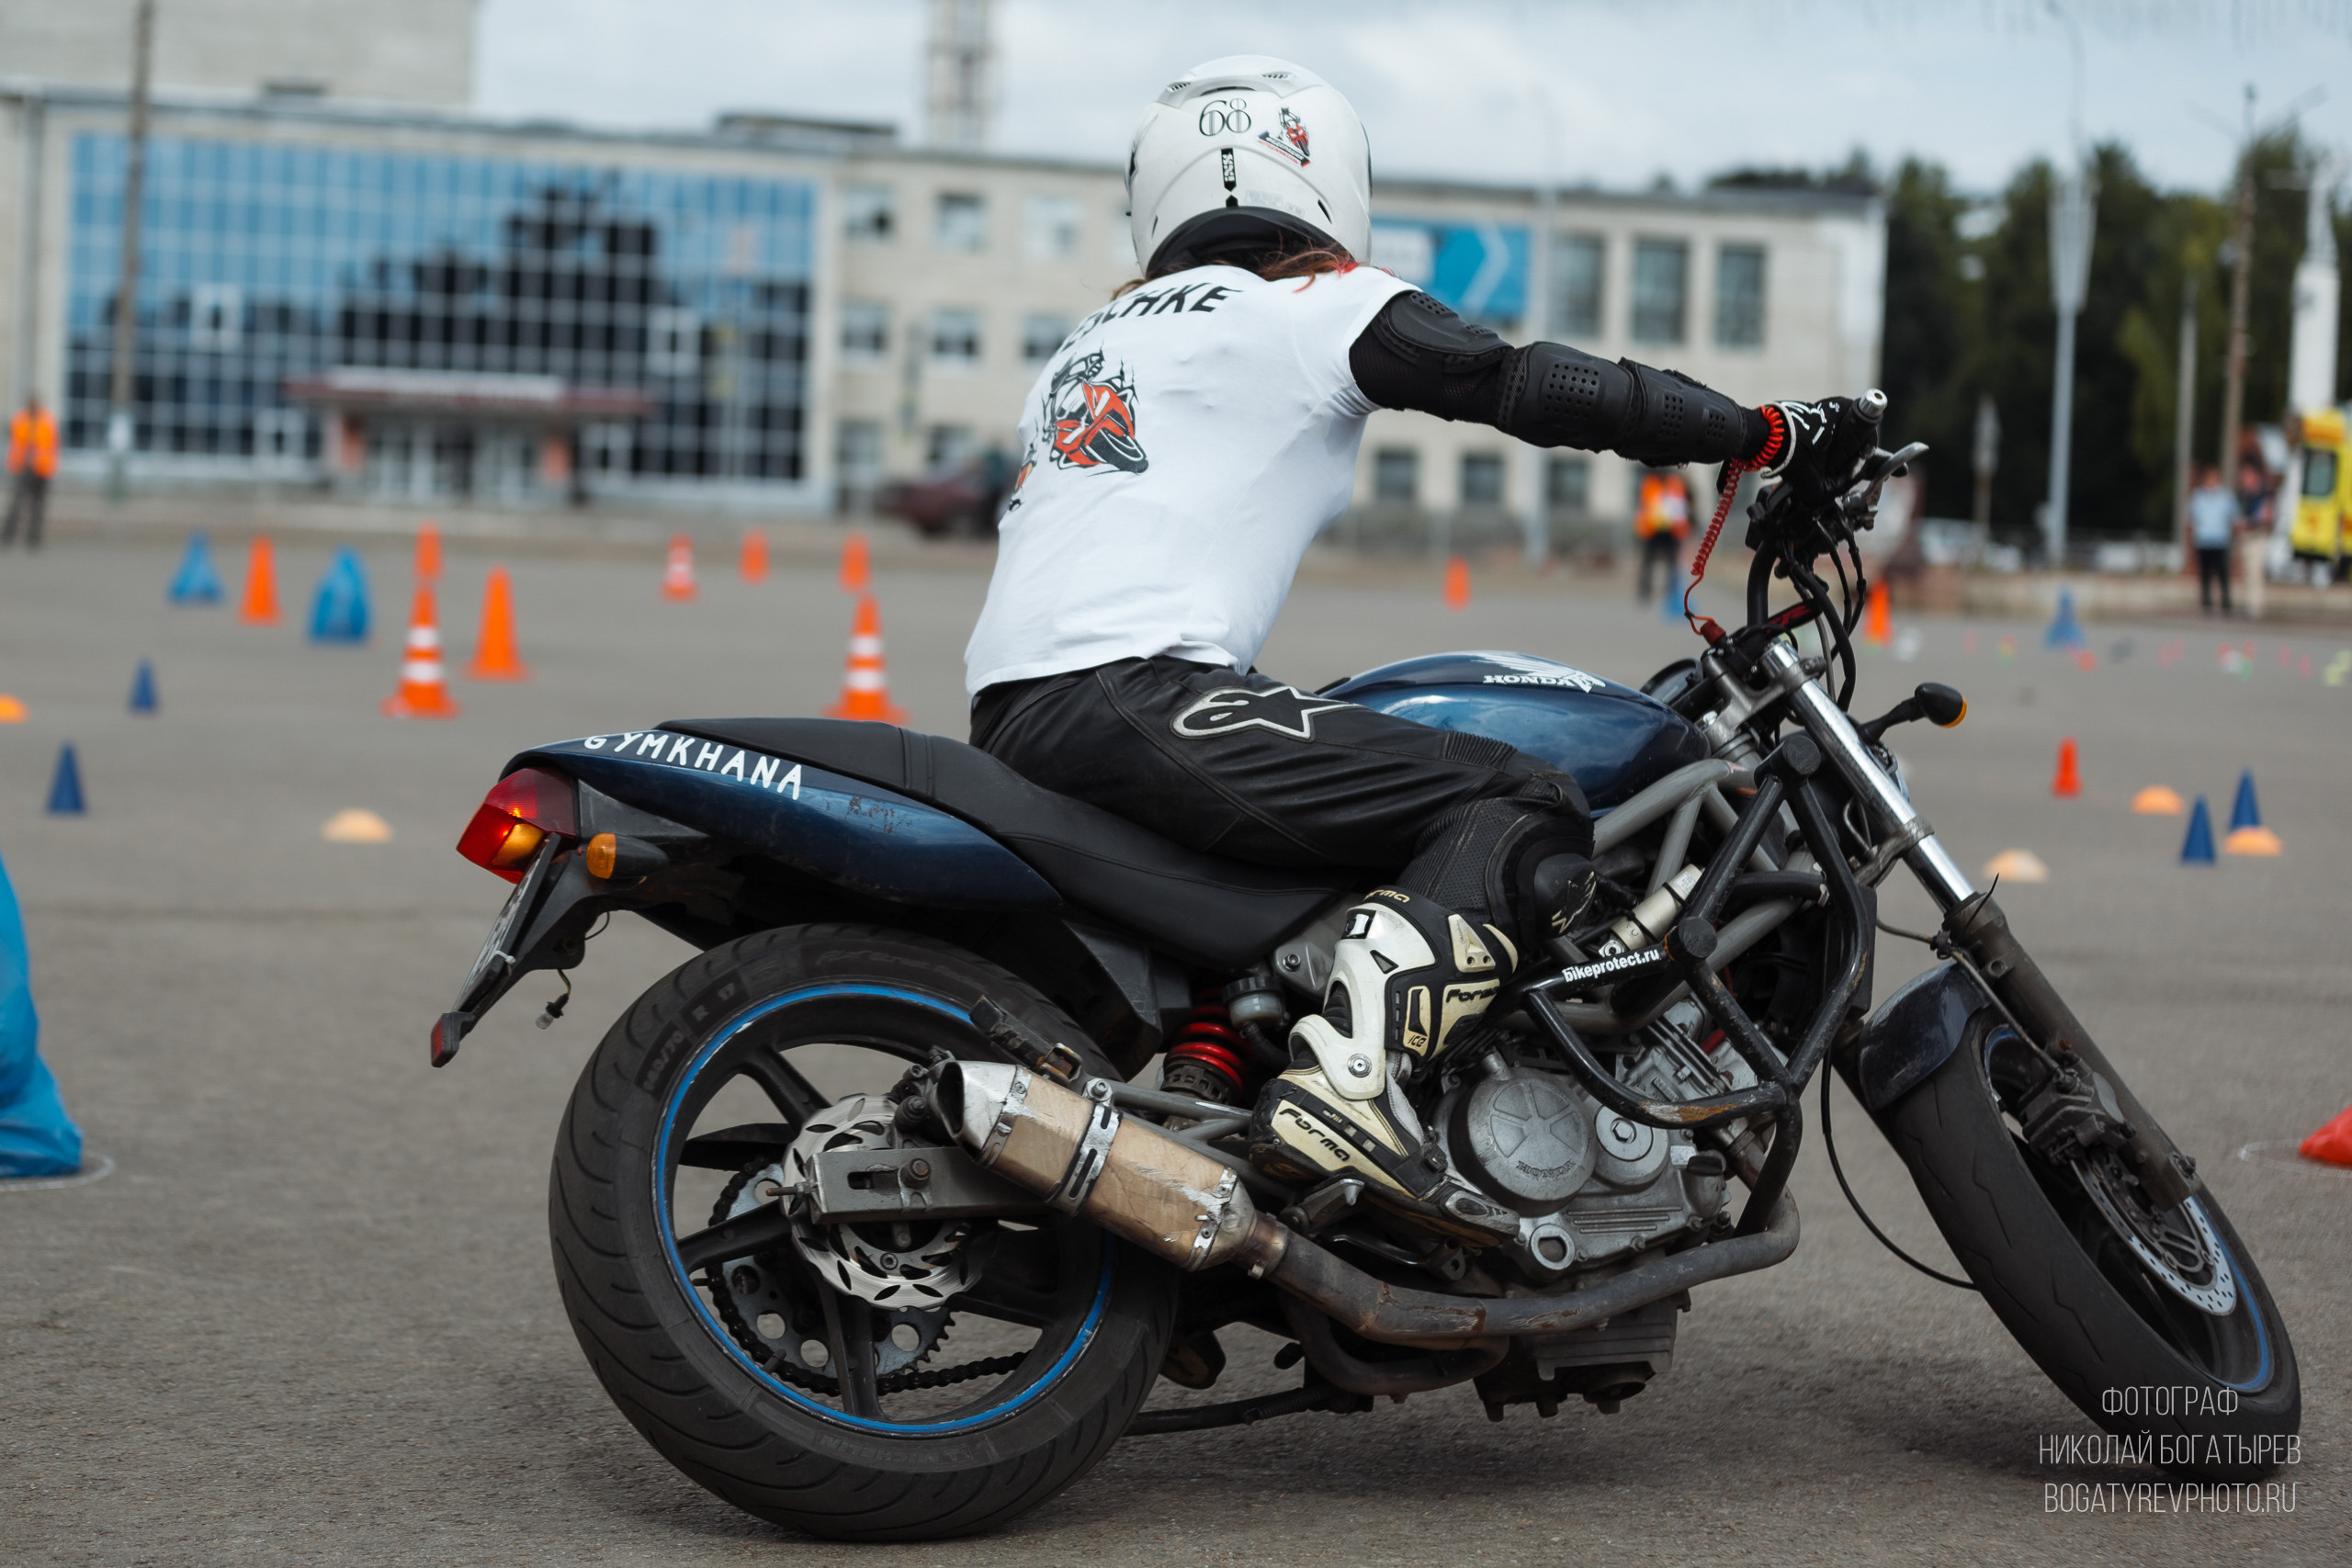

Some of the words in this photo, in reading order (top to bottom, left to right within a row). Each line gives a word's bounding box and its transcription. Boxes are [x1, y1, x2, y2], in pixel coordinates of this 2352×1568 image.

[1198, 97, 1252, 137] 68
[1483, 674, 1577, 687] HONDA
[583, 732, 802, 800] GYMKHANA
[1562, 947, 1660, 983] bikeprotect.ru
[1279, 1108, 1351, 1162] Forma
[1515, 1157, 1577, 1179] HONDA
